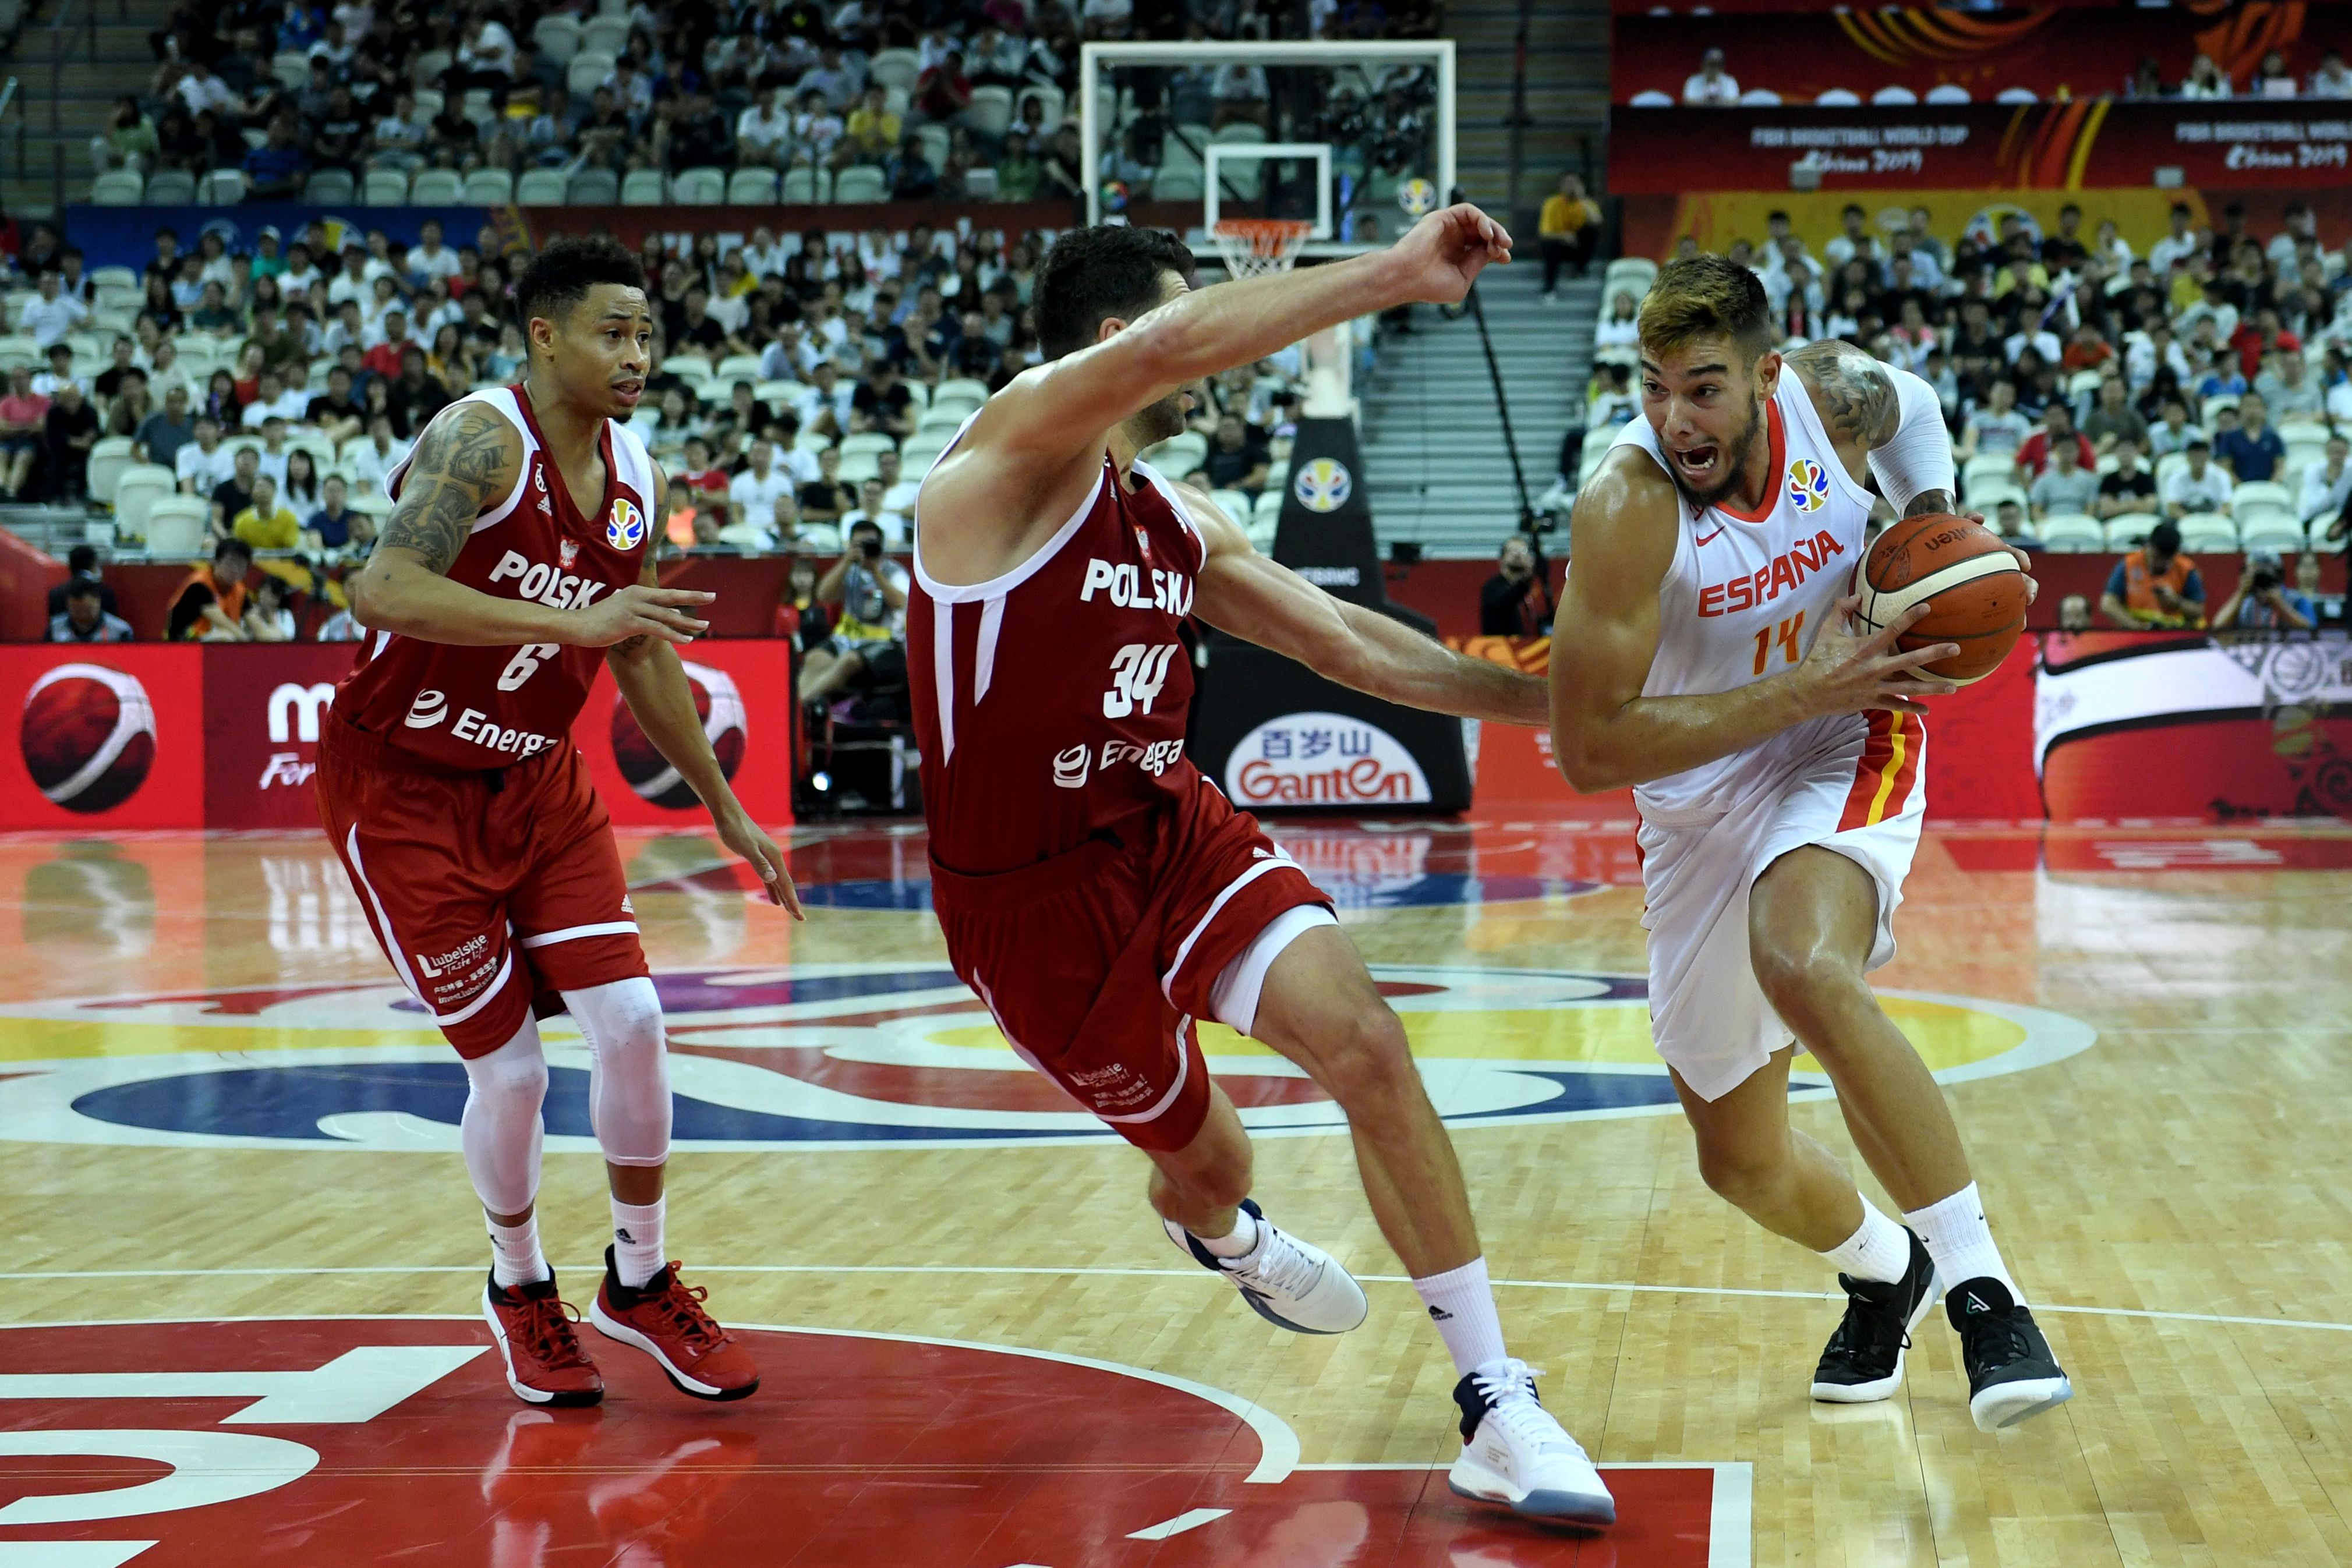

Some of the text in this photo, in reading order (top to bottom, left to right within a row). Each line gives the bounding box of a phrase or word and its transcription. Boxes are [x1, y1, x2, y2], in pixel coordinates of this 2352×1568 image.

[2308, 121, 2352, 141] WORL
[489, 550, 623, 610] POLSK
[1080, 558, 1194, 617] POLSKA
[1698, 530, 1844, 617] ESPAÑA
[497, 643, 561, 692] 6
[1753, 609, 1805, 676] 14
[1103, 644, 1178, 718] 34
[1099, 739, 1184, 777] Enega
[1262, 729, 1371, 759] 百岁山
